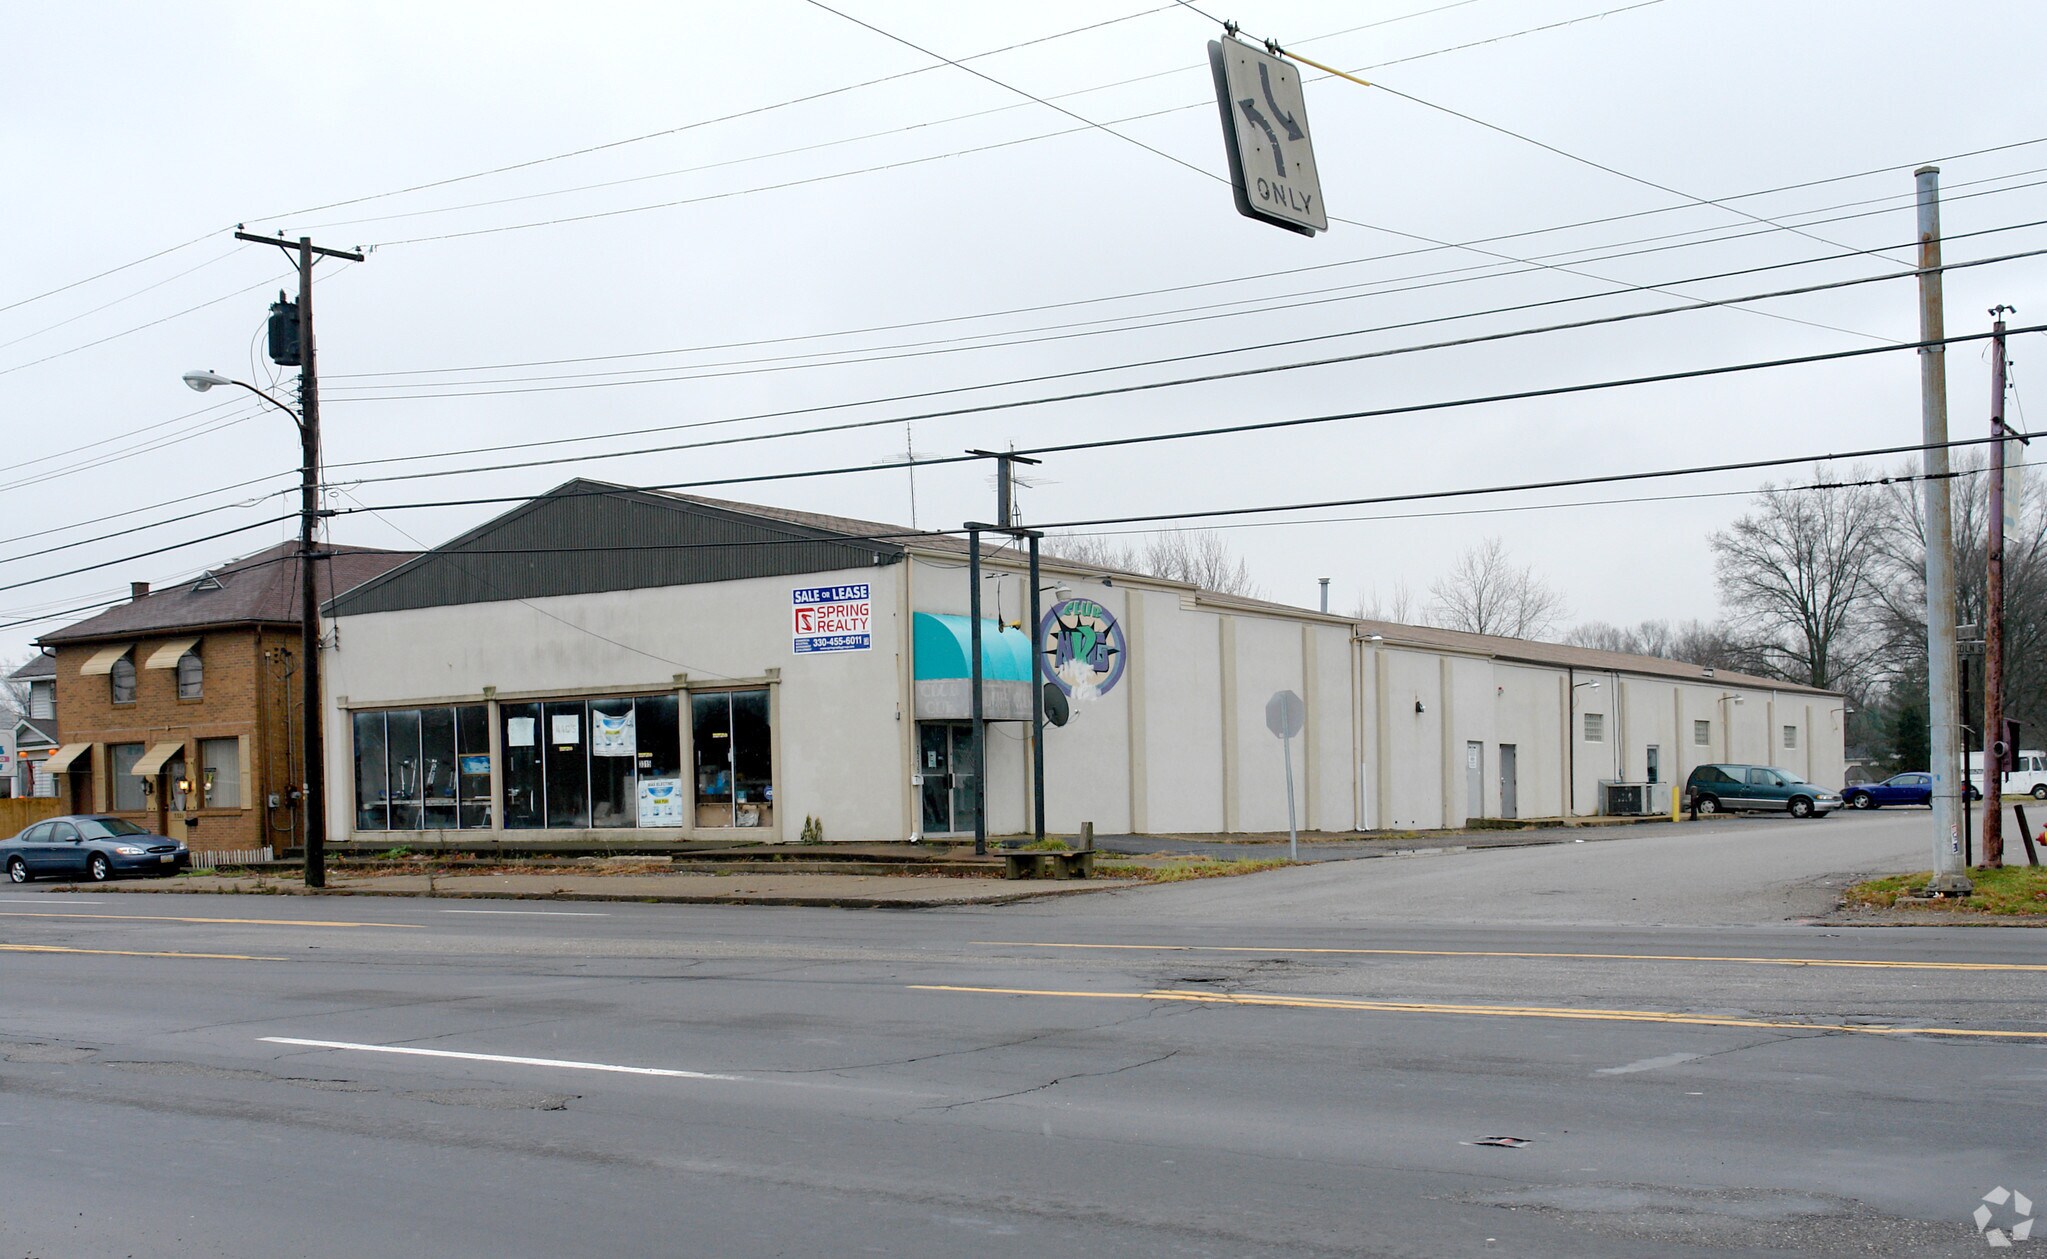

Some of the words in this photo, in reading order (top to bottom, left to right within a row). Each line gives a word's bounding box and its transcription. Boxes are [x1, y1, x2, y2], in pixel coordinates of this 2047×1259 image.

[1257, 177, 1311, 215] ONLY
[795, 590, 820, 603] SALE
[832, 585, 867, 600] LEASE
[817, 603, 869, 619] SPRING
[1063, 600, 1103, 618] CLUB
[817, 617, 868, 633] REALTY
[813, 636, 861, 647] 330-455-6011
